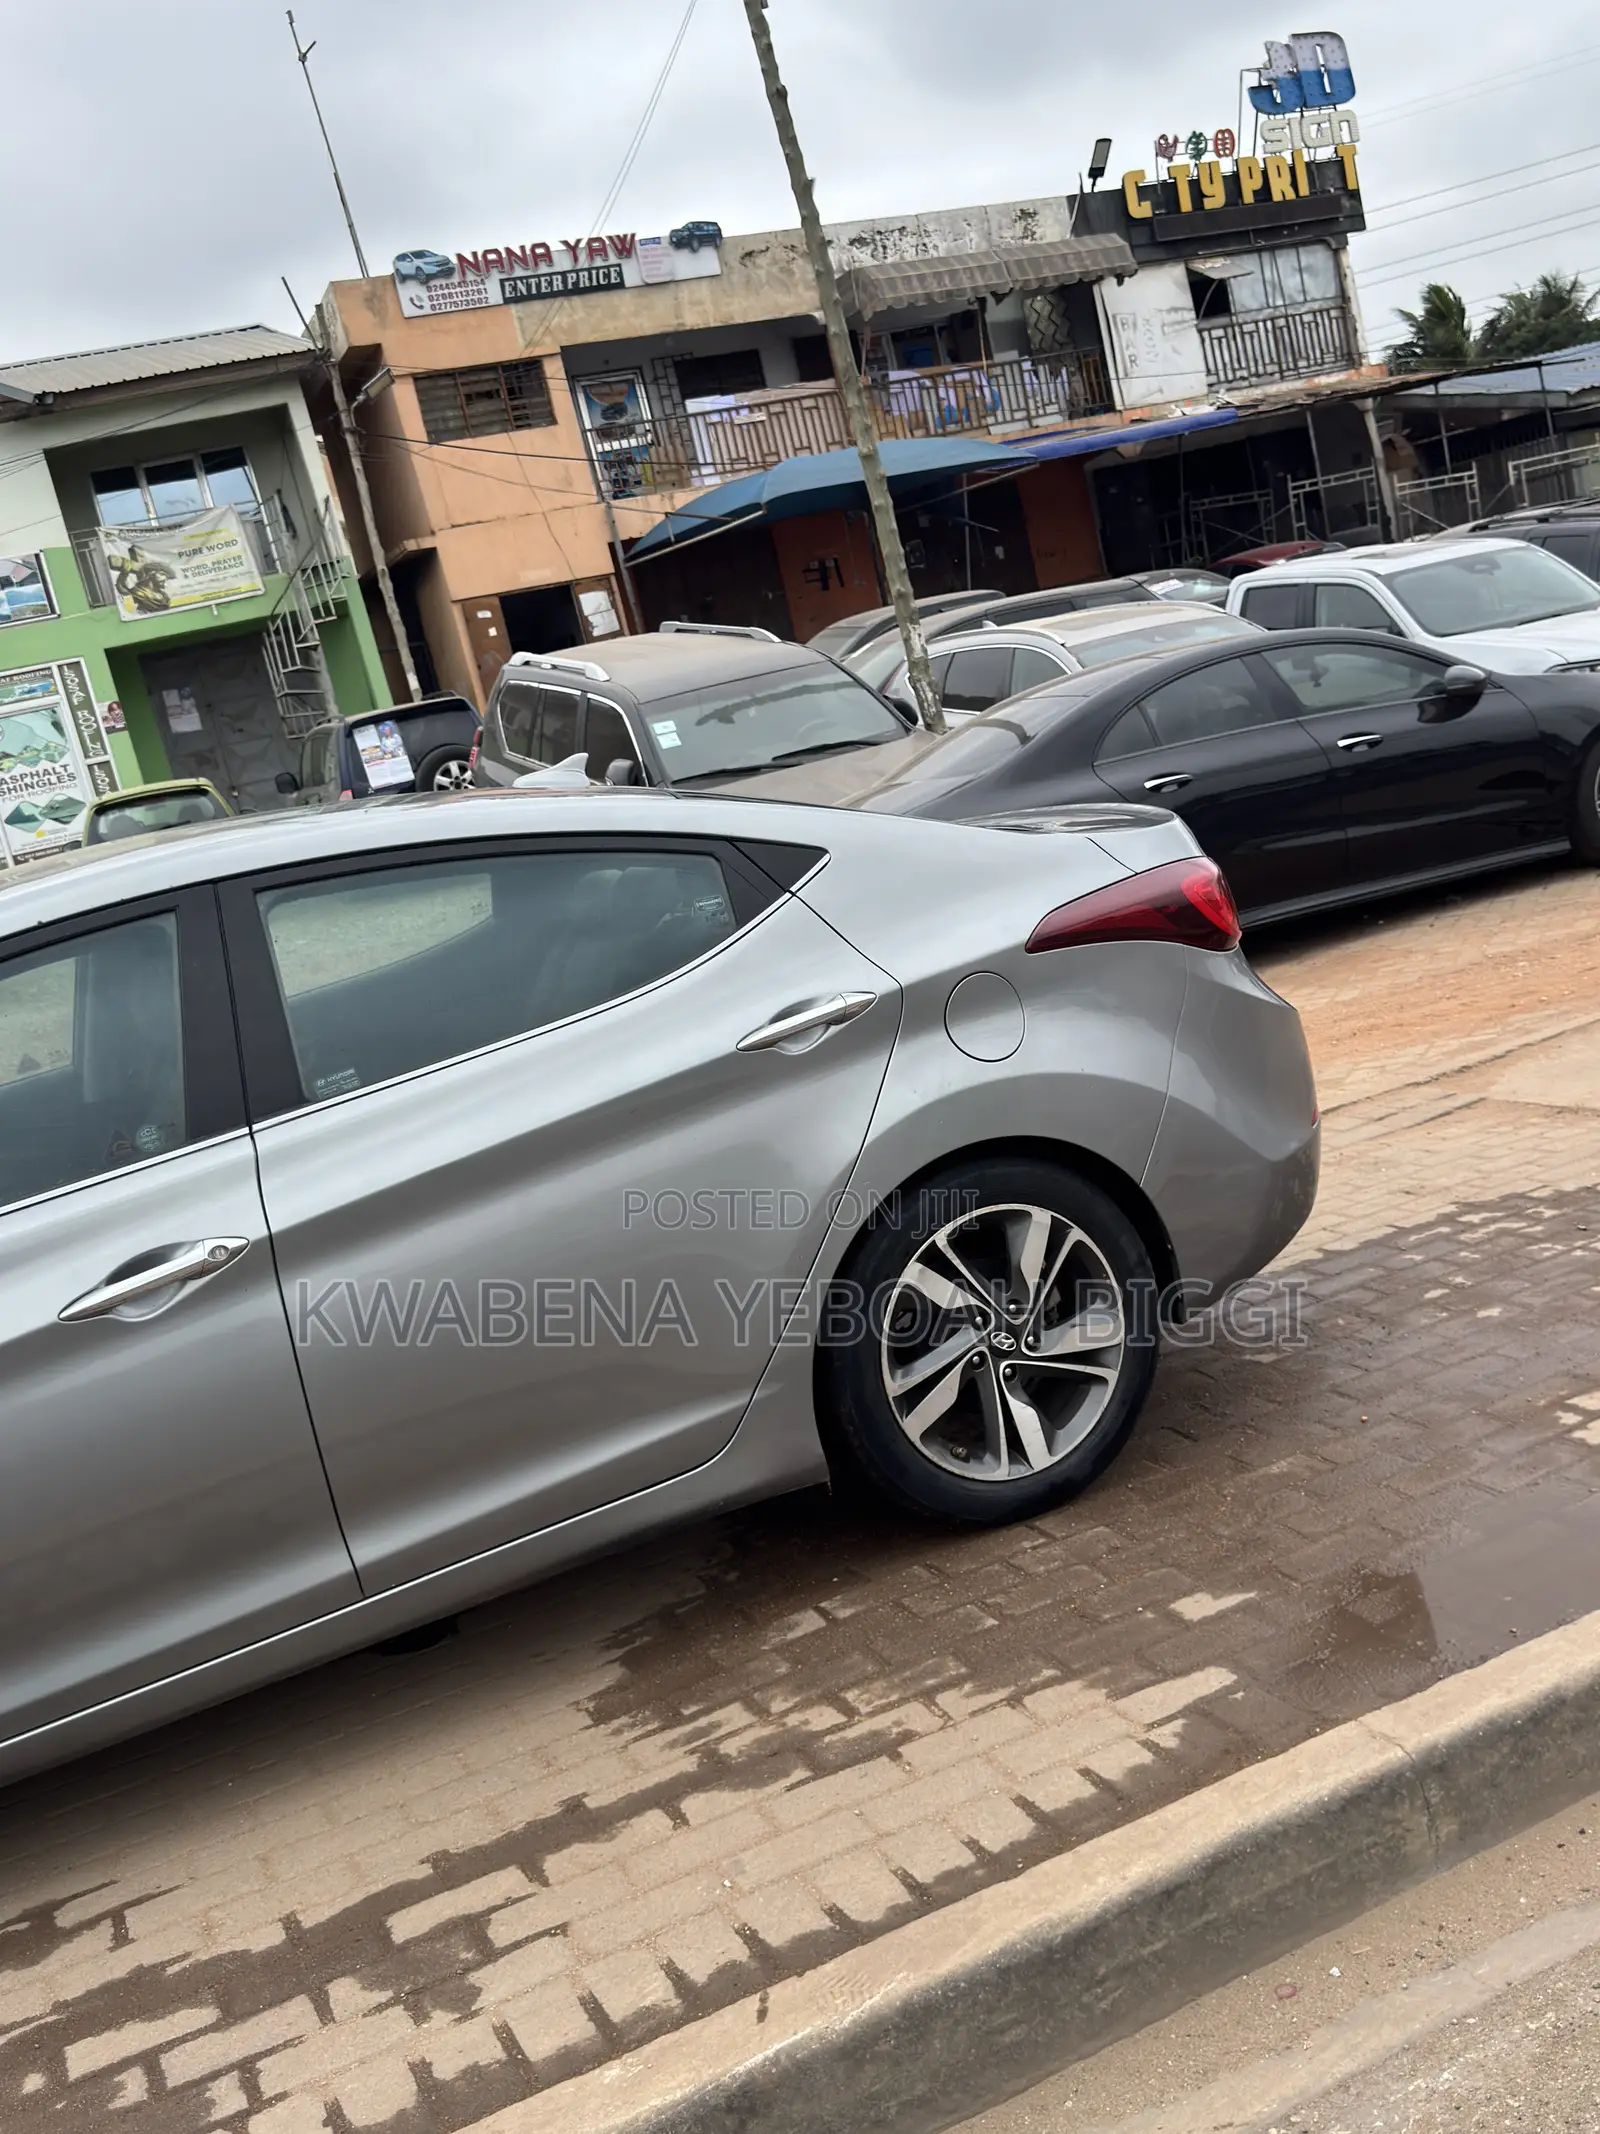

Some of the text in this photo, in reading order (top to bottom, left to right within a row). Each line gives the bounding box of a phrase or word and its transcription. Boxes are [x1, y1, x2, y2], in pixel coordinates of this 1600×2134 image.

[456, 242, 553, 278] NANA
[559, 233, 637, 267] YAW
[428, 288, 488, 302] 0208113261
[178, 539, 238, 559] PURE WORD
[211, 554, 242, 566] PRAYER
[191, 561, 244, 578] DELIVERANCE
[0, 763, 70, 786] ASPHALT
[0, 772, 77, 797] SHINGLES
[27, 782, 78, 798] ROOFING
